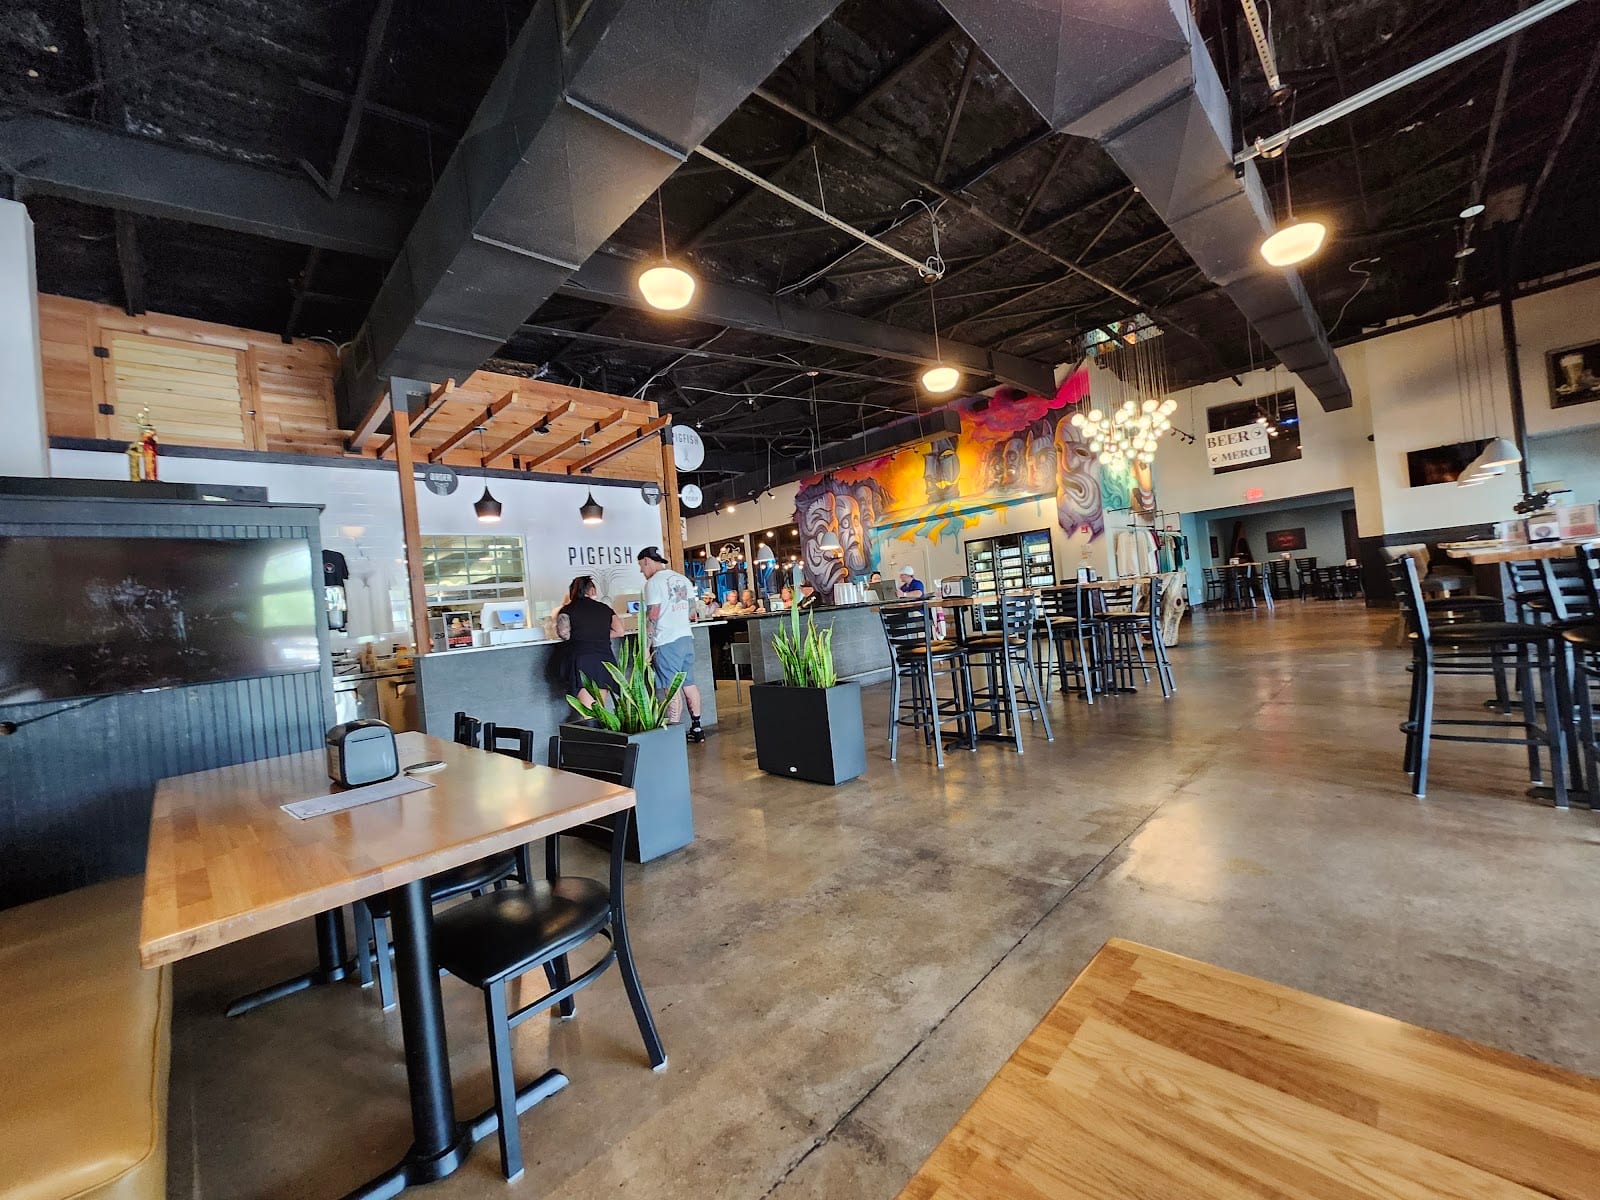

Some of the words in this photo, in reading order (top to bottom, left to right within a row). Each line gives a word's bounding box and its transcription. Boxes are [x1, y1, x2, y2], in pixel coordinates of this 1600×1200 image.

[673, 432, 699, 446] IGFISH
[1208, 430, 1250, 448] BEER
[1221, 445, 1268, 461] MERCH
[568, 546, 632, 565] PIGFISH
